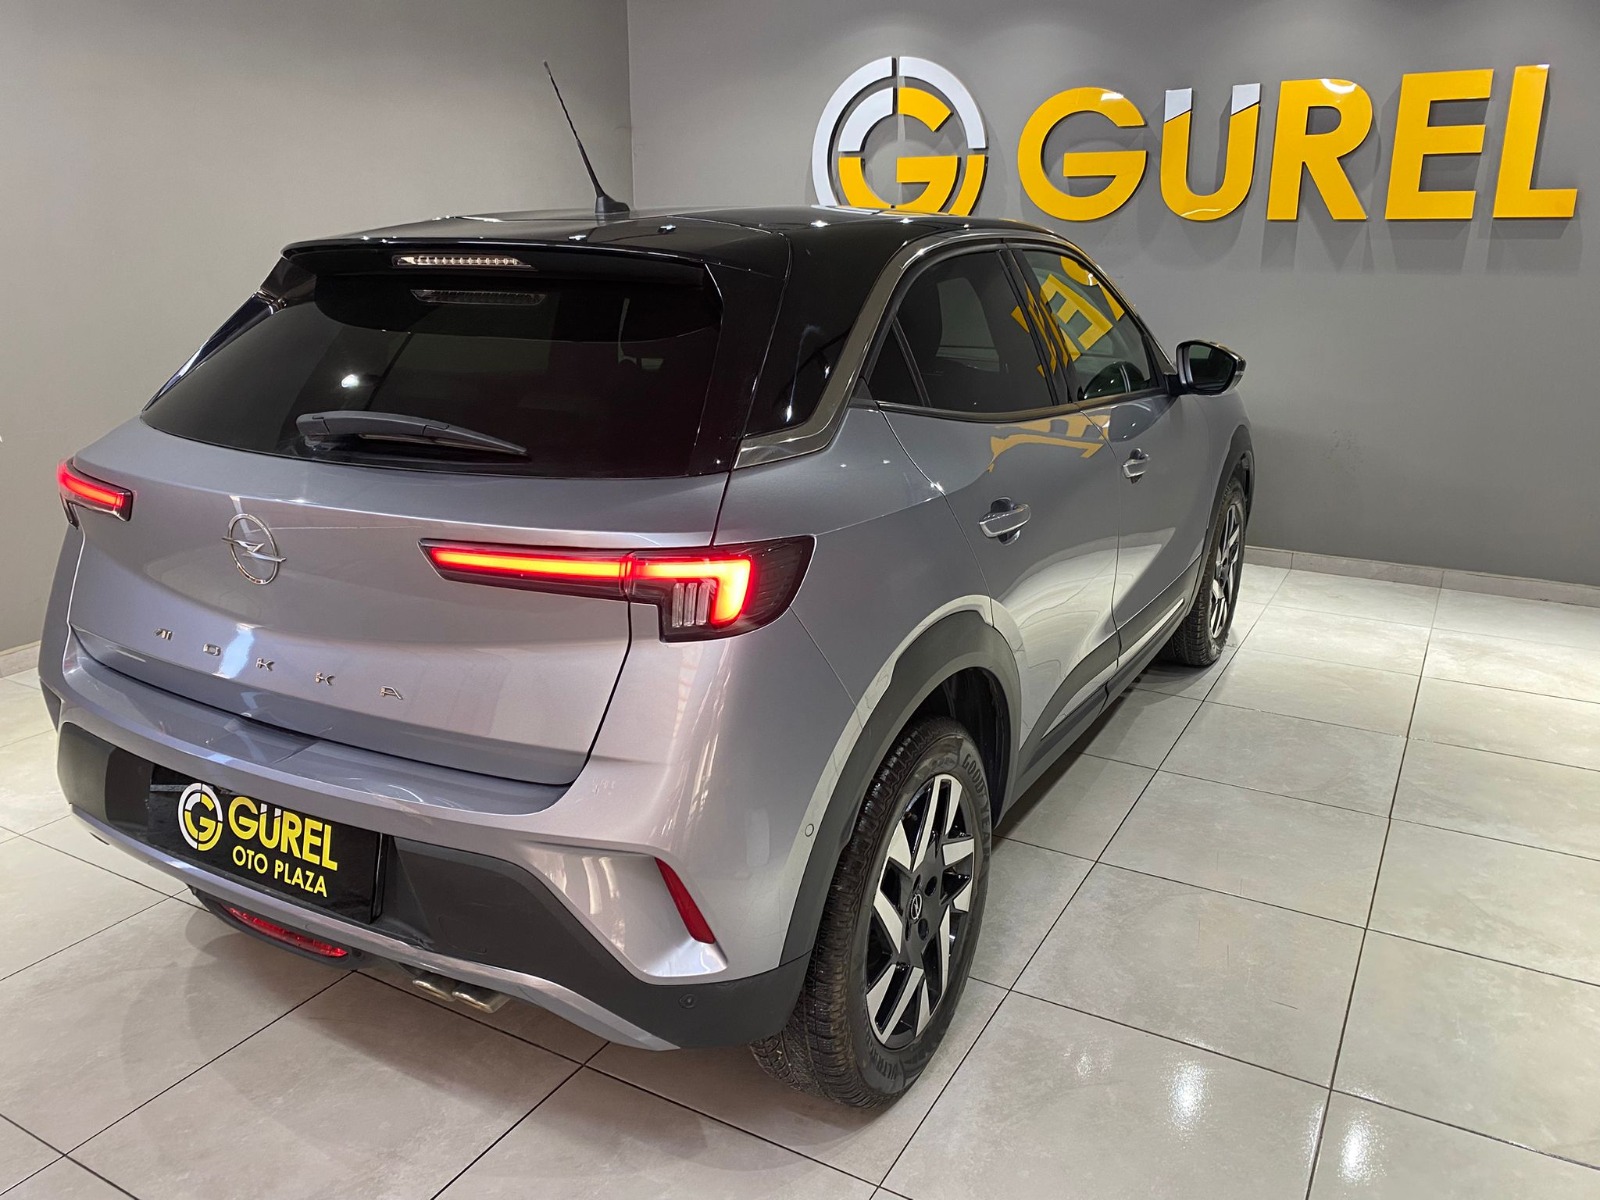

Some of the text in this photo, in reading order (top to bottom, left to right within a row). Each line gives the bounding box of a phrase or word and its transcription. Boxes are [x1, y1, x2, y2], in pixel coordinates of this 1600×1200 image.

[154, 628, 404, 701] MOKKA
[232, 845, 328, 898] OTO PLAZA
